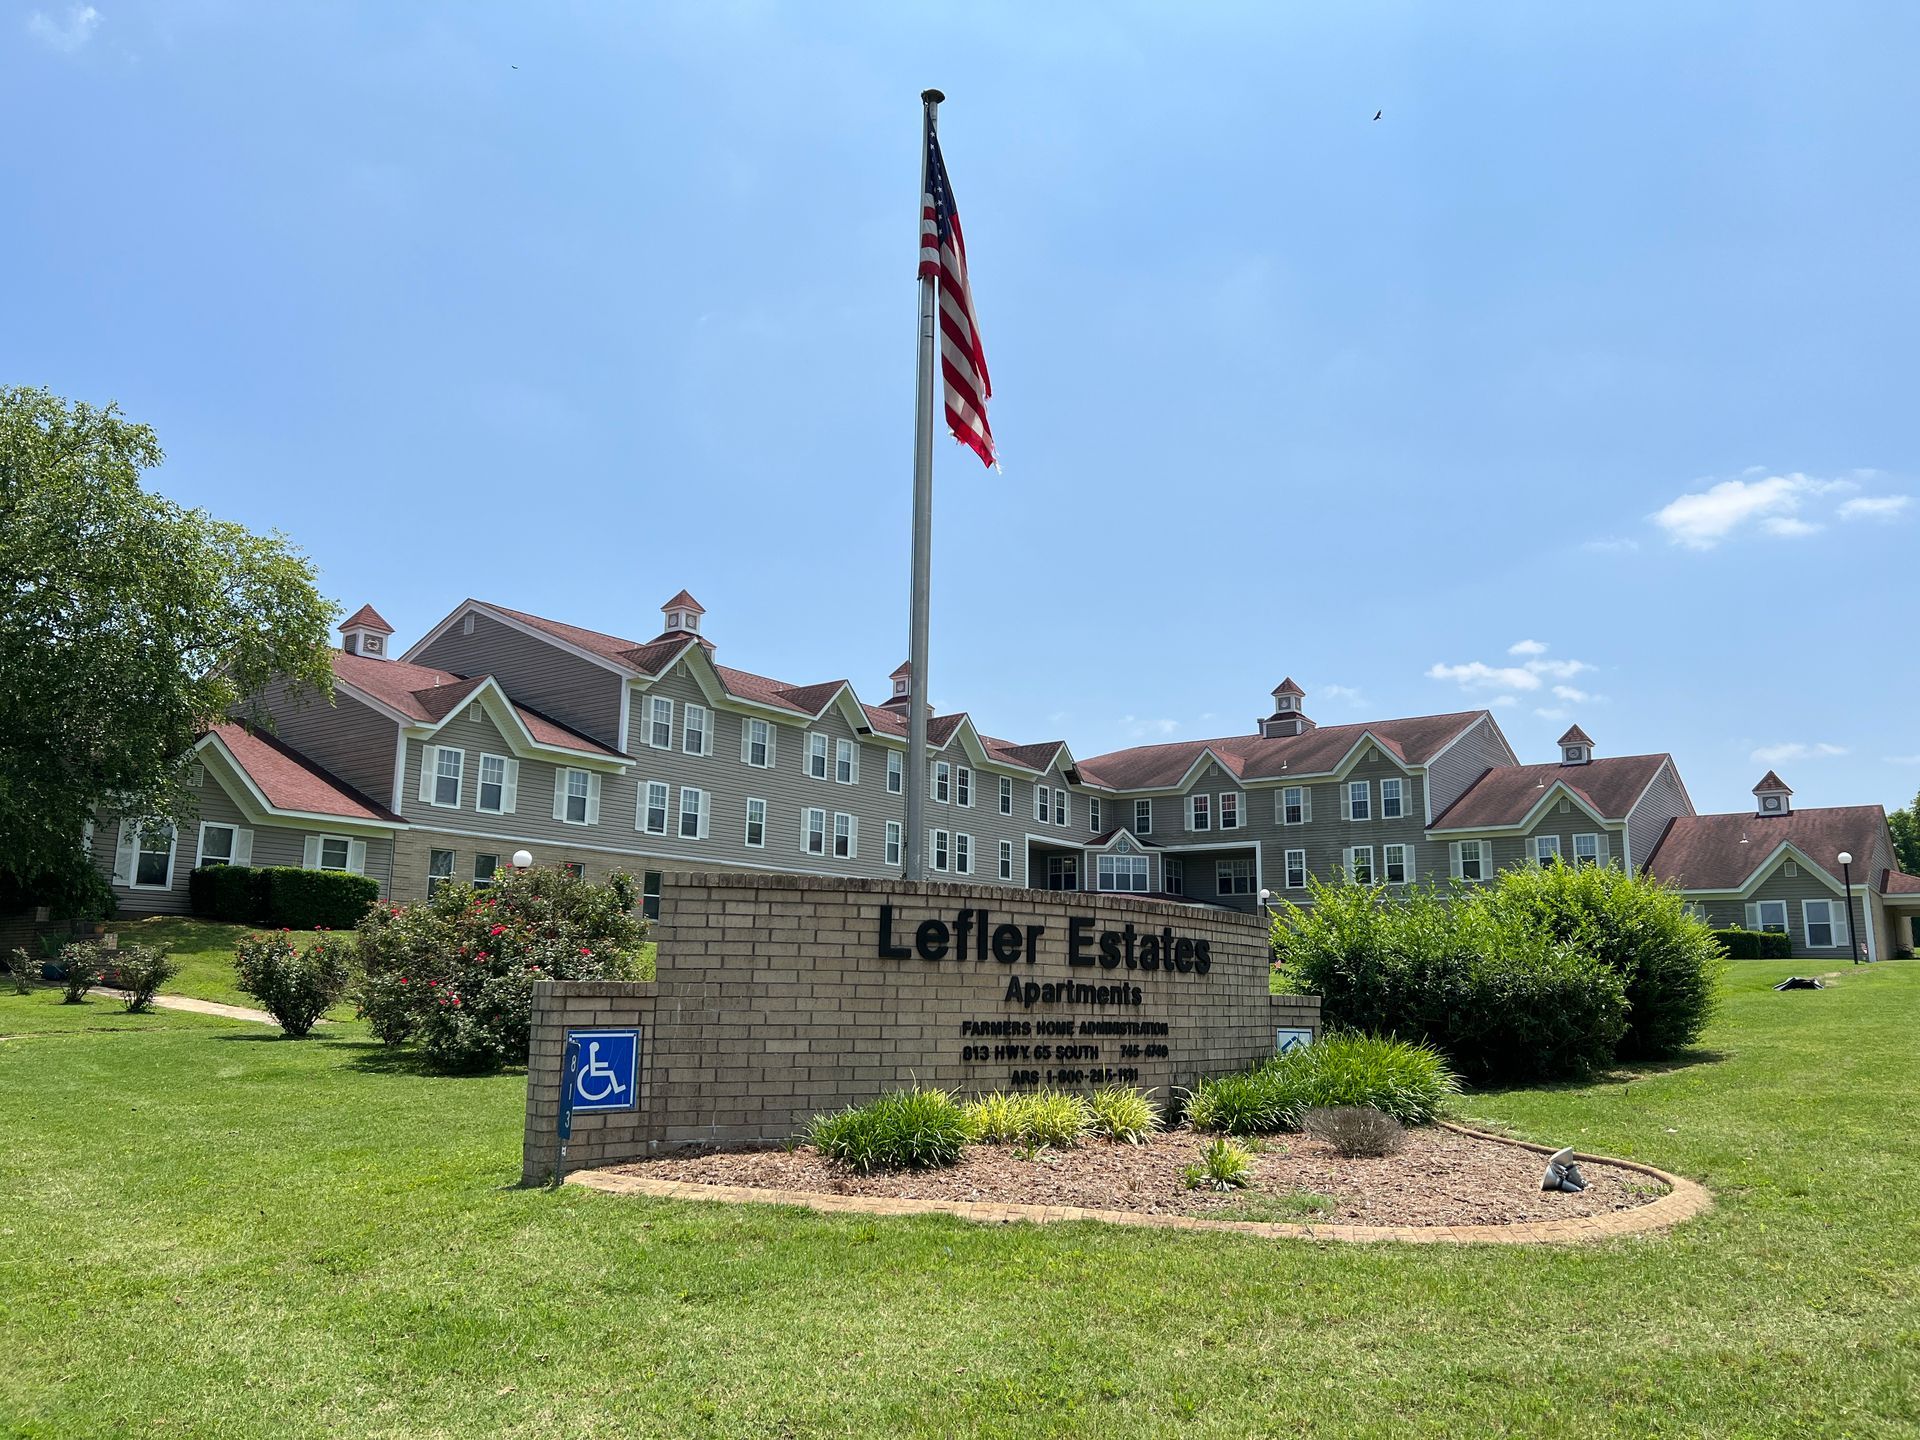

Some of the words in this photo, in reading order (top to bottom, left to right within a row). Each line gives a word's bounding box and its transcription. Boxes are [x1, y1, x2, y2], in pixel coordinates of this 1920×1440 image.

[878, 905, 1045, 964] Lefler
[1068, 916, 1212, 975] Estates
[1005, 975, 1142, 1008] Apartments
[962, 1020, 1032, 1036] FARMERS
[1036, 1020, 1075, 1036] HOME
[1079, 1021, 1169, 1036] ADMINISTRATION
[962, 1045, 990, 1061] 813
[1033, 1045, 1052, 1060] 65
[1055, 1045, 1099, 1060] SOUTH
[1011, 1069, 1040, 1085] ARS
[564, 1055, 577, 1128] 813
